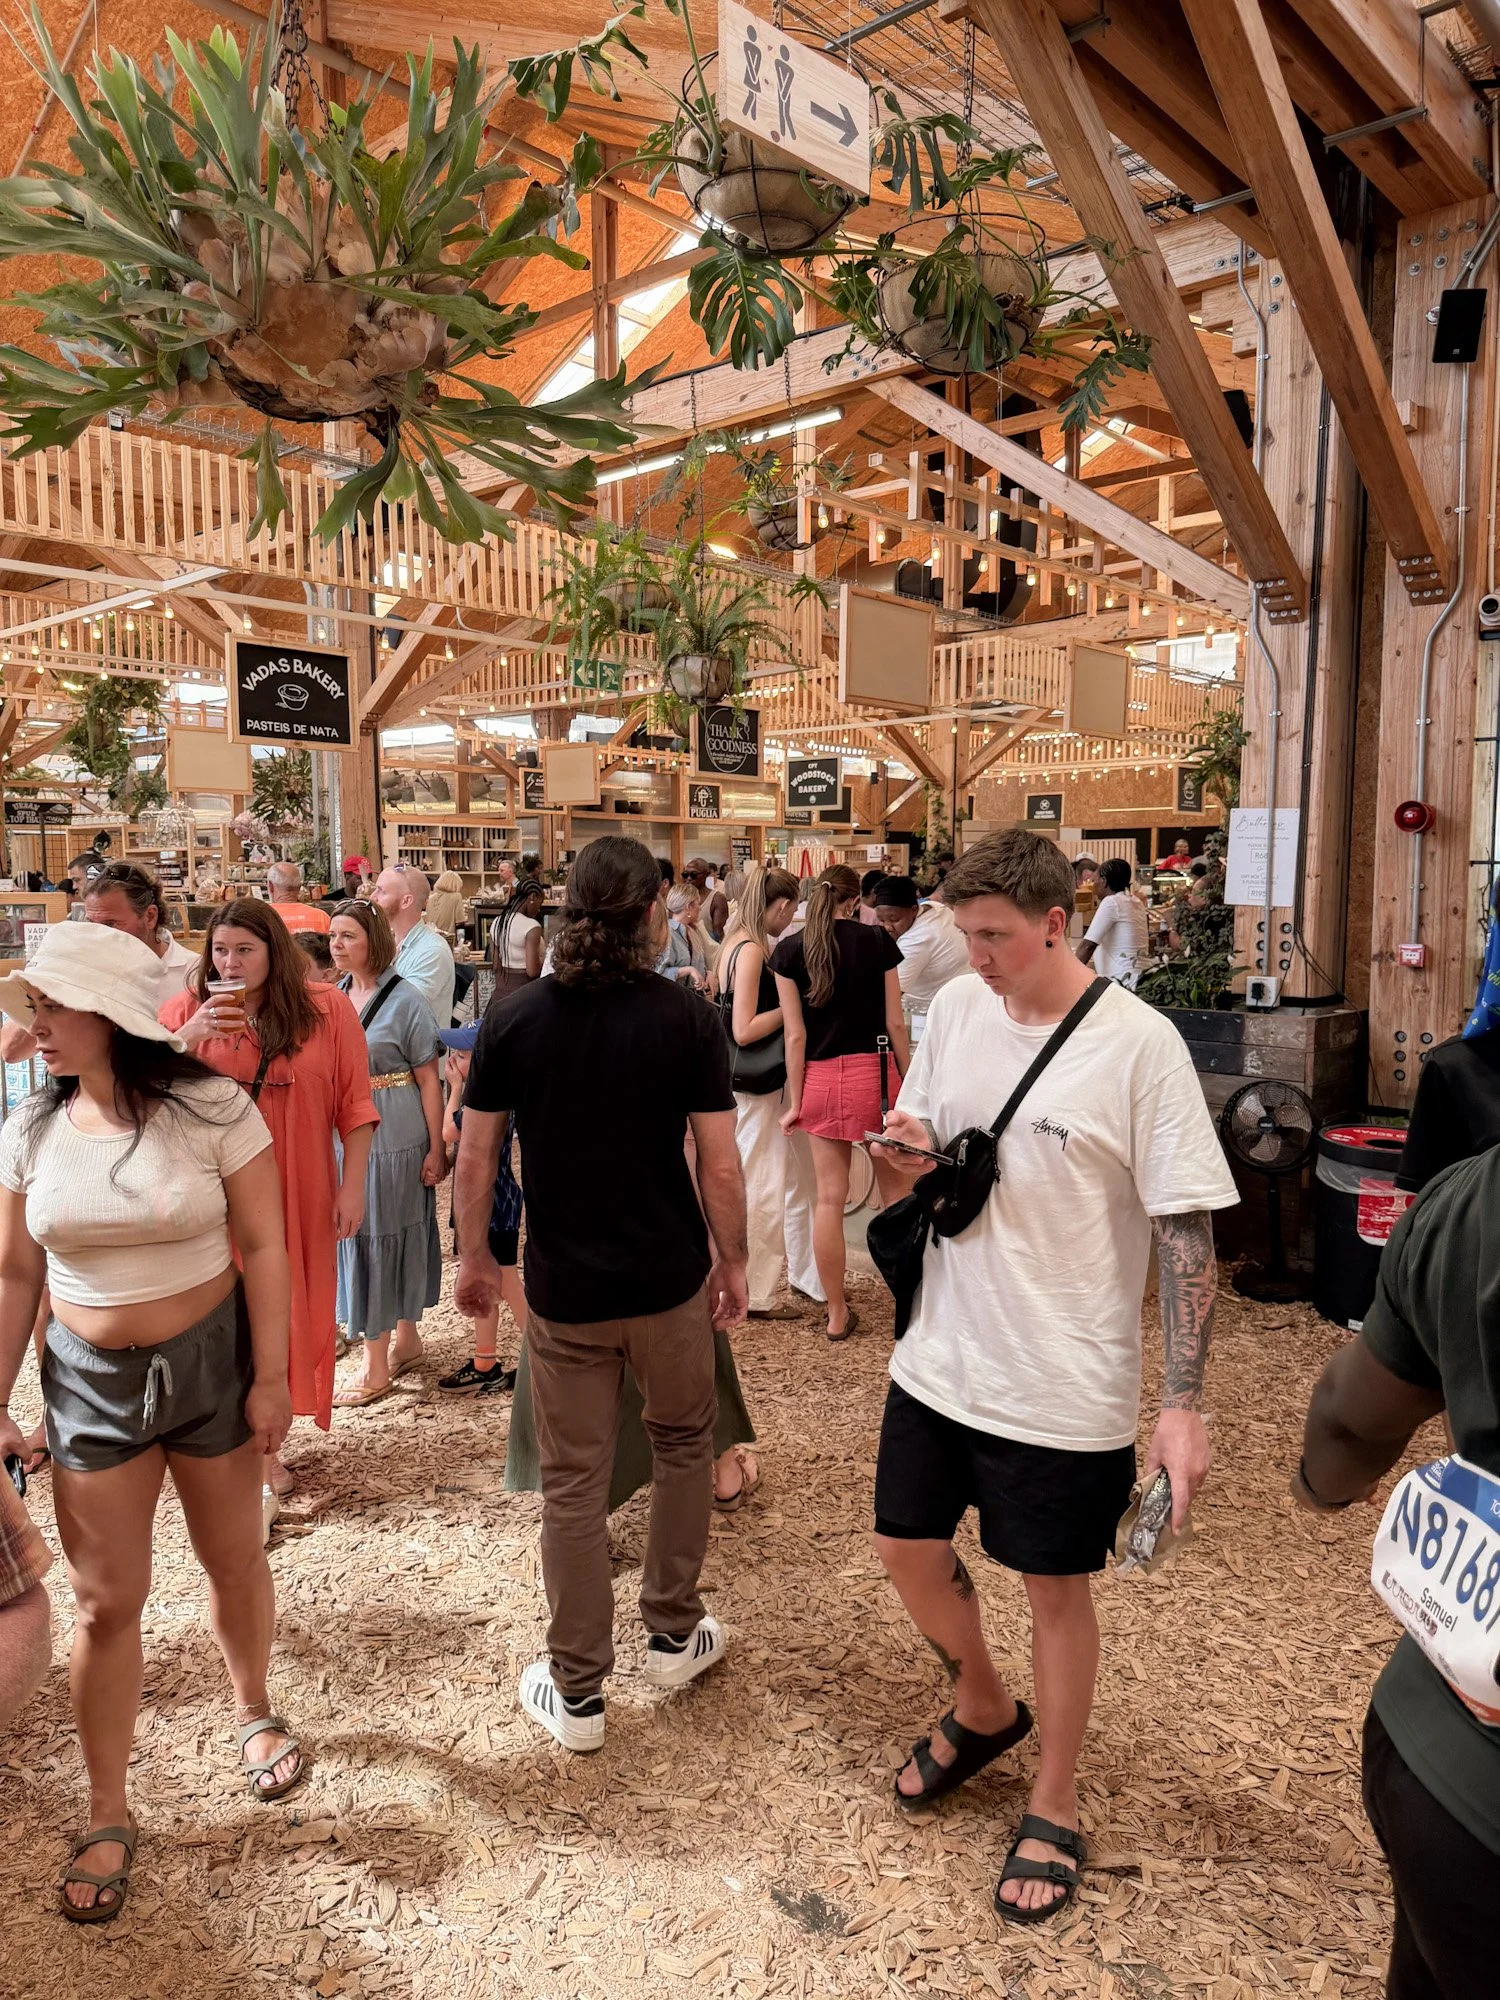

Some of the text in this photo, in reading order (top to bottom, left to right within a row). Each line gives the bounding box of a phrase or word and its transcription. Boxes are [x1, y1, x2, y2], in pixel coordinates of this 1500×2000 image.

[242, 658, 345, 700] VADAS BAKERY
[246, 719, 339, 738] PASTEIS DE NATA
[707, 738, 757, 755] GOODNESS
[790, 770, 836, 787] WOODSTOCK
[798, 785, 827, 793] BAKERY
[691, 808, 718, 818] PUGLIA
[1421, 1587, 1458, 1632] Samuel
